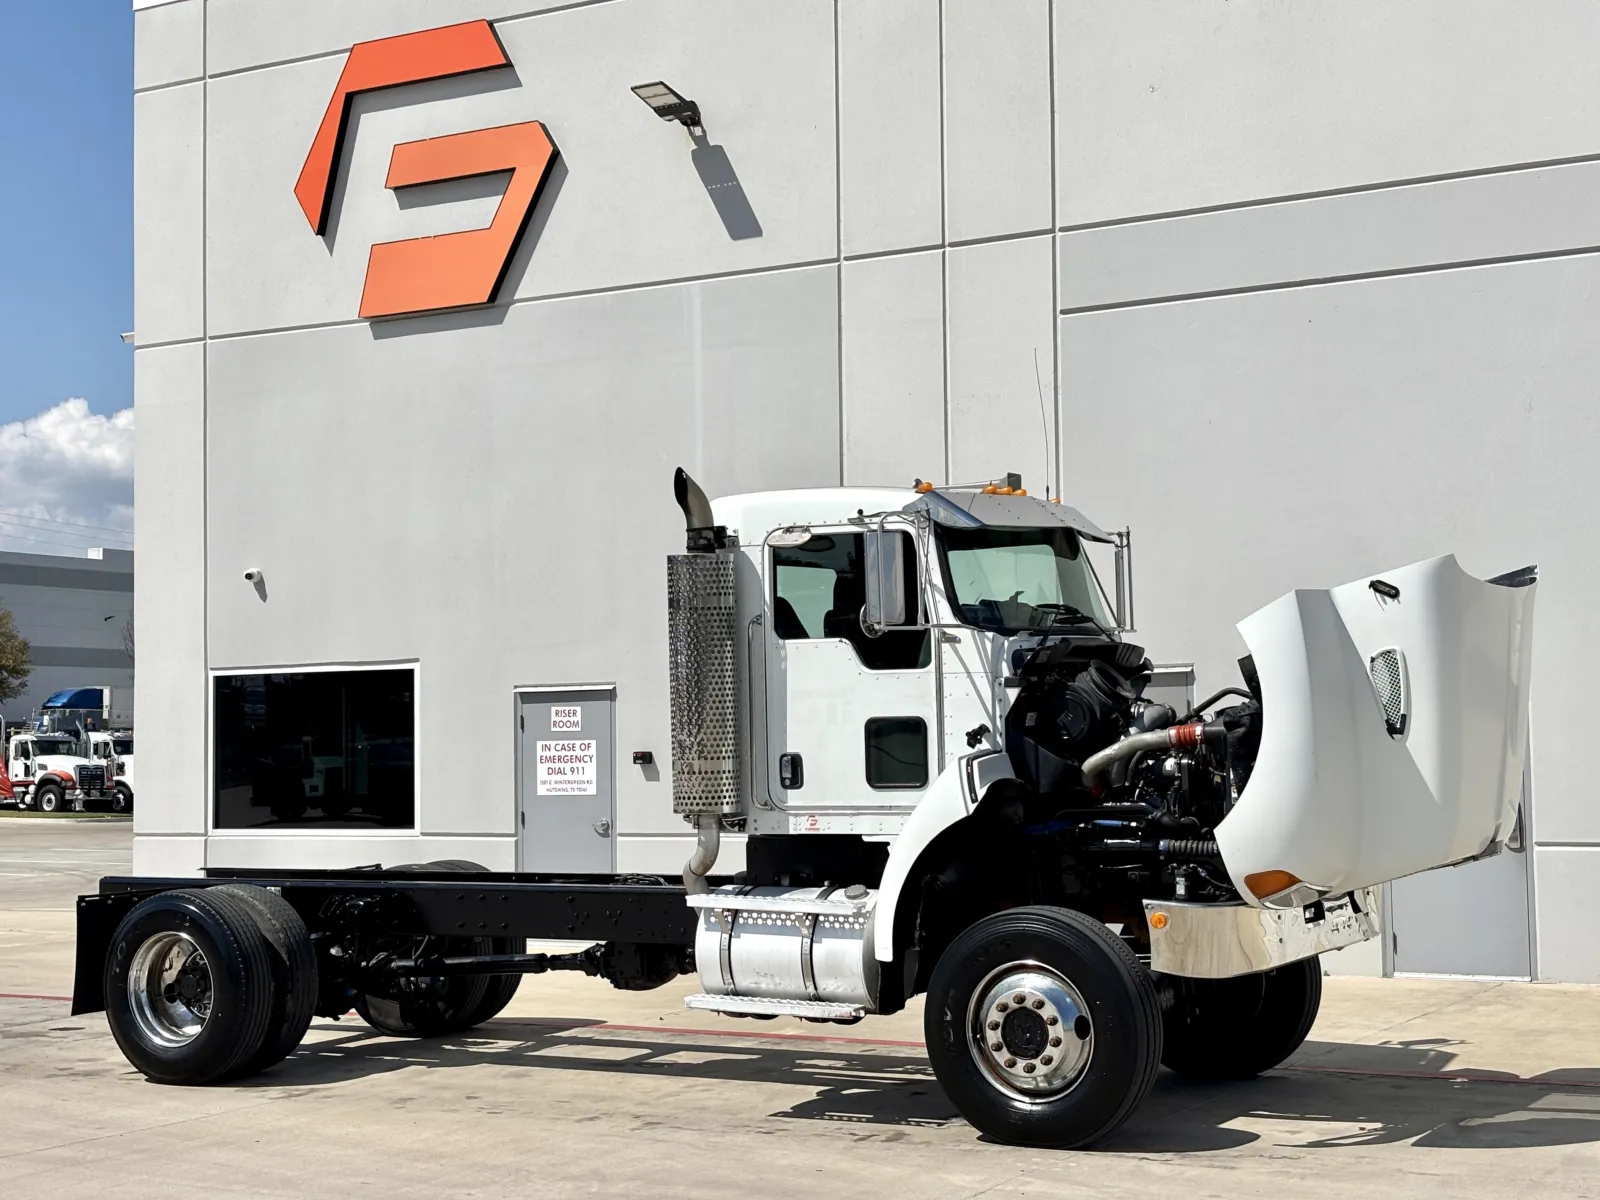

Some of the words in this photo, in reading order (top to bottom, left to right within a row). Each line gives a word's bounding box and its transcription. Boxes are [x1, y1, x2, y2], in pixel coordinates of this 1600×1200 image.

[555, 709, 577, 718] RISER
[552, 720, 580, 728] ROOM
[541, 743, 551, 752] IN
[554, 743, 576, 752] CASE
[579, 742, 592, 751] OF
[540, 754, 594, 764] EMERGENCY
[547, 766, 567, 775] DIAL
[569, 766, 585, 775] 911
